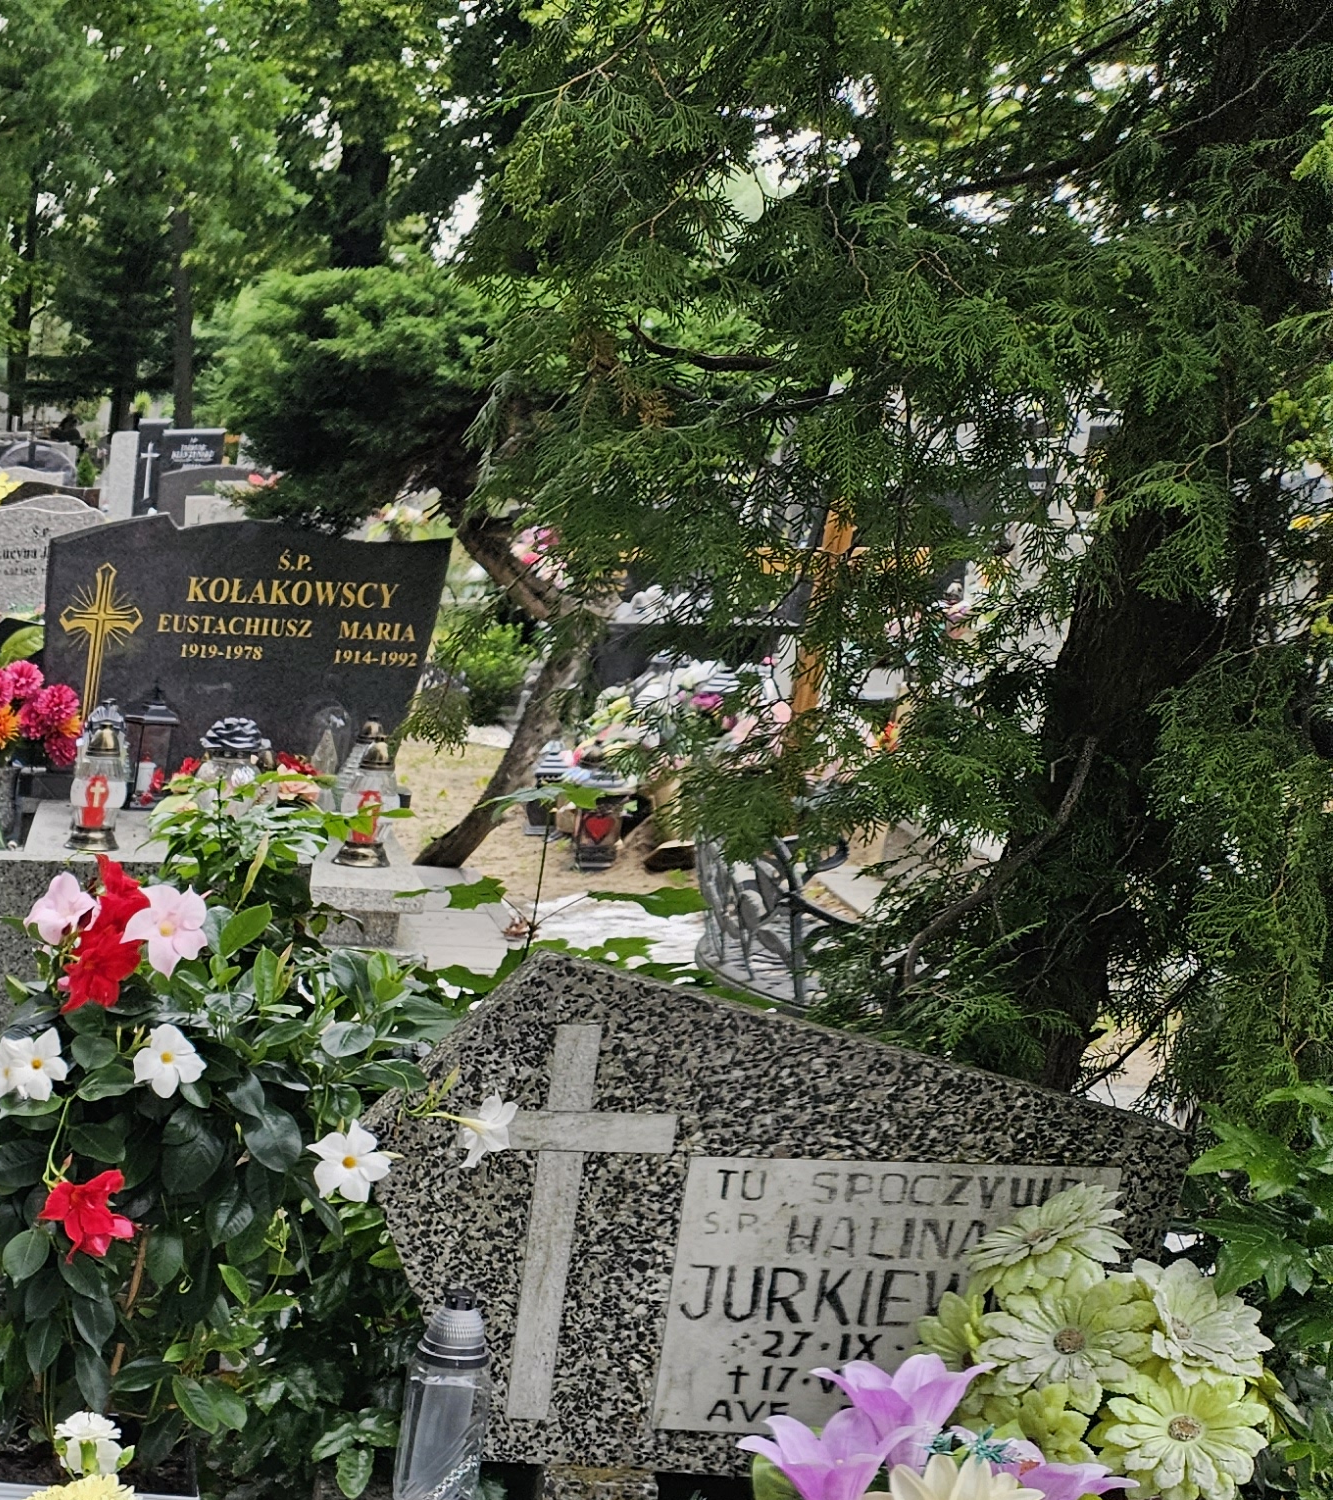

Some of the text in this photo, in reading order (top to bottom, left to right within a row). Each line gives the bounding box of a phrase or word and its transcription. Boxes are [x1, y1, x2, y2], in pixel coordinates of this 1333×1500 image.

[186, 576, 400, 609] KOŁAKOWSCY
[156, 613, 416, 643] EUSTACHIUSZ MARIA
[180, 643, 418, 668] 1919-1978 1914-1992
[717, 1168, 768, 1201] TU
[785, 1214, 988, 1261] HALINA
